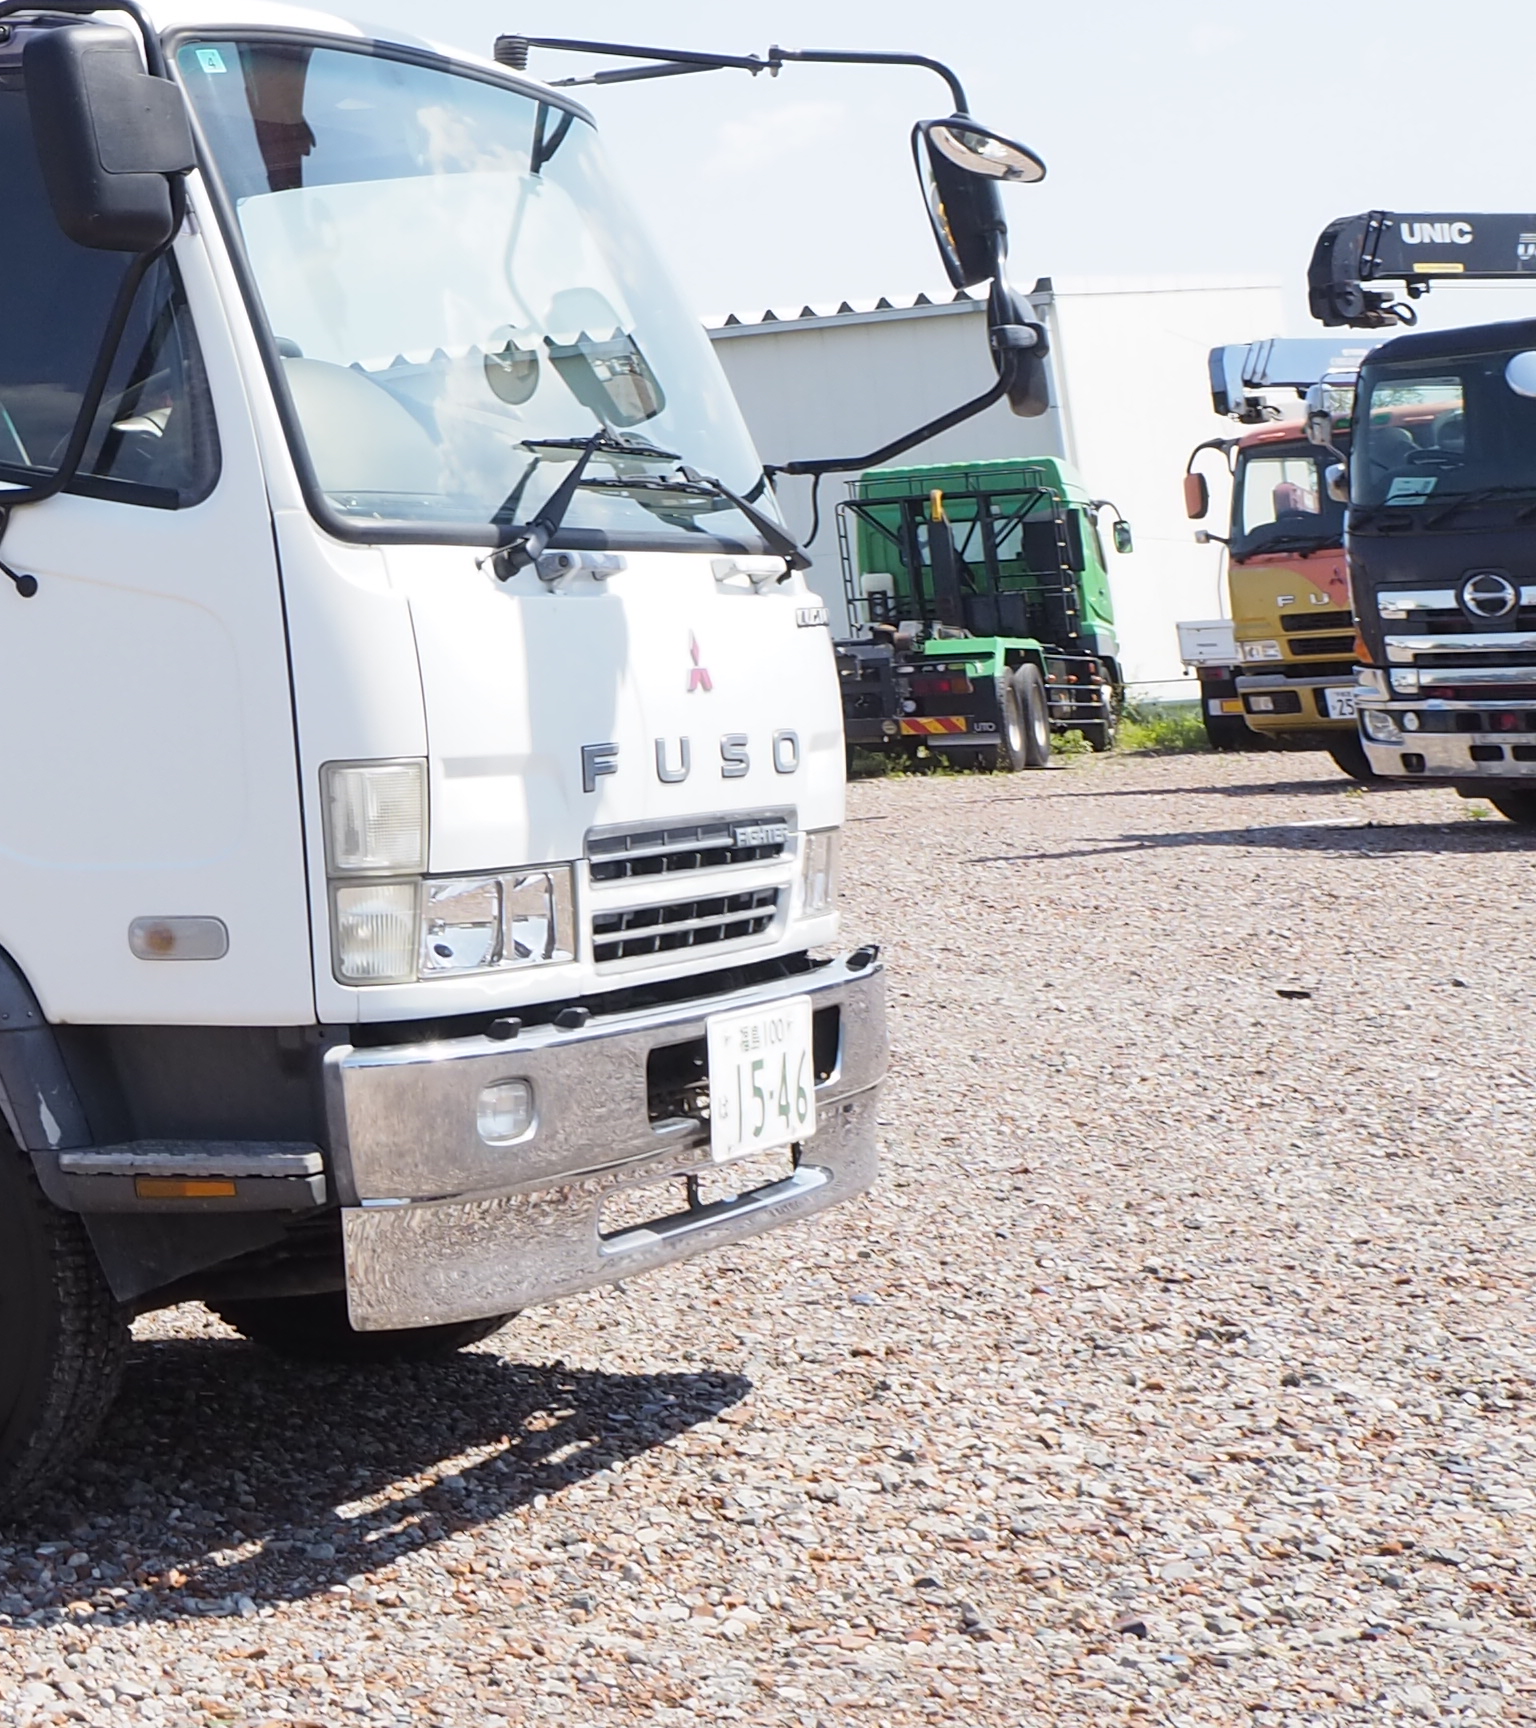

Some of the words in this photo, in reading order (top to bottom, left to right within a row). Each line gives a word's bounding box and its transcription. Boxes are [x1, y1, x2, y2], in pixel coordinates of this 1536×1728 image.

[1400, 221, 1473, 244] UNIC
[581, 728, 800, 794] FUSO
[737, 1050, 807, 1143] 15-46
